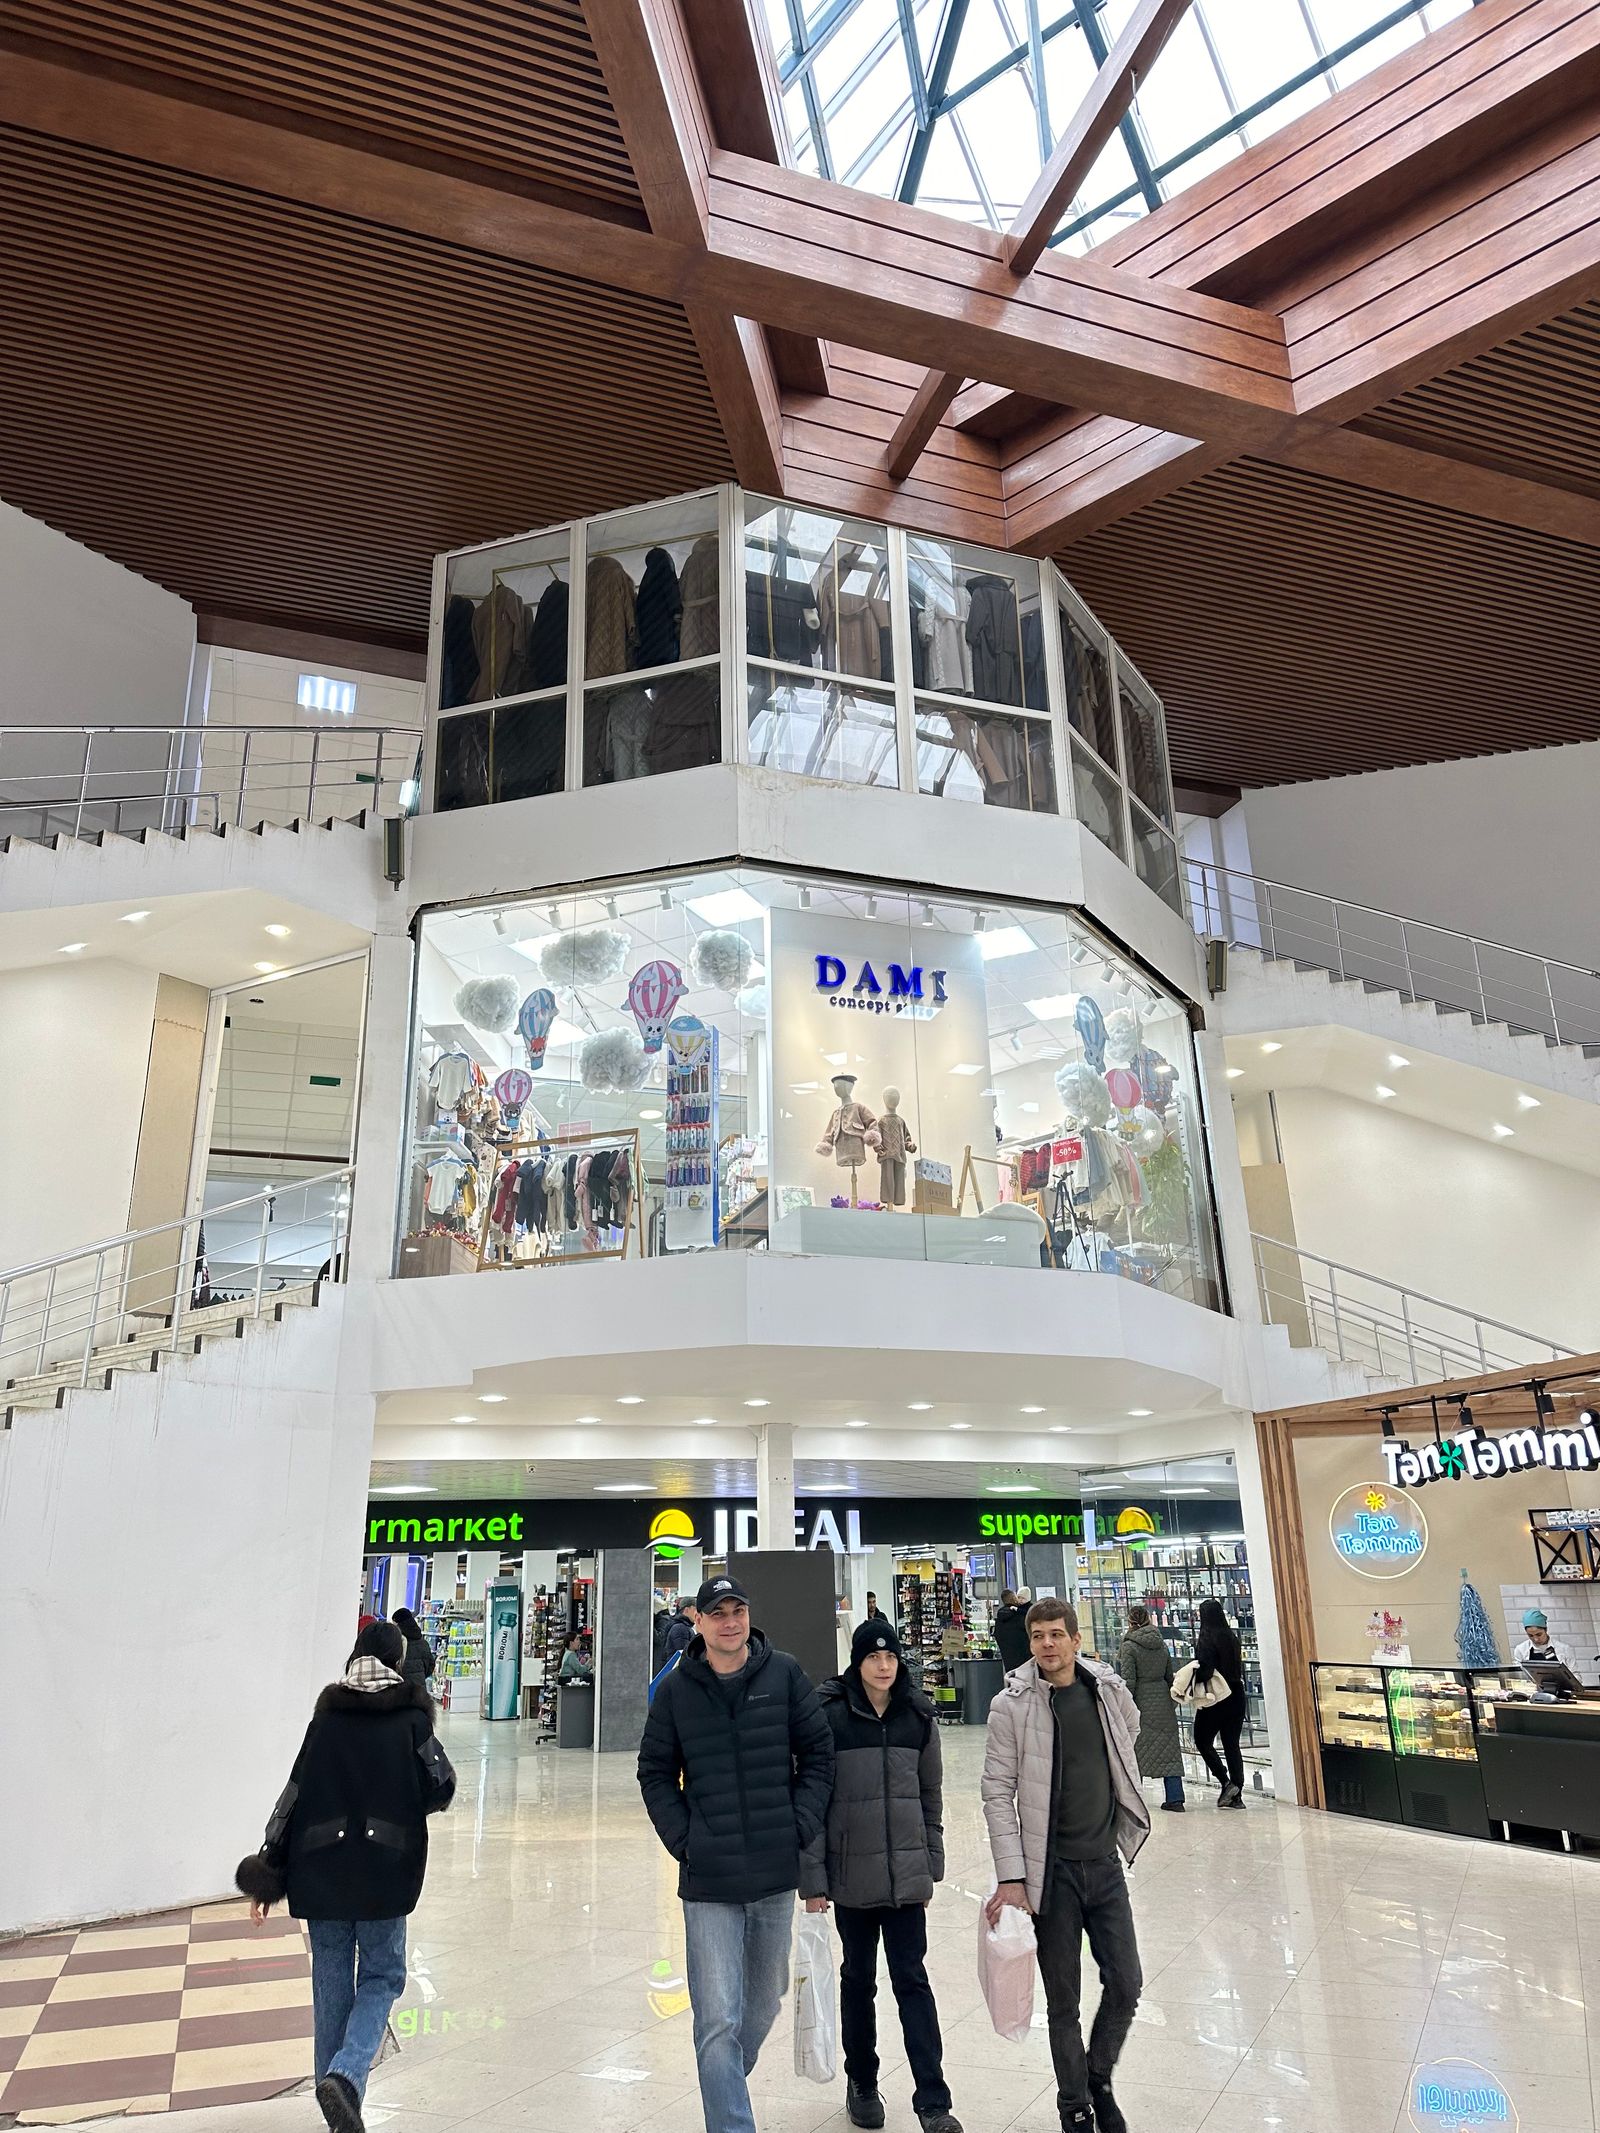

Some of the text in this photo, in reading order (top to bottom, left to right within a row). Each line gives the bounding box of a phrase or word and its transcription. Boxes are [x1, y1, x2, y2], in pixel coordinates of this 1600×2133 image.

[814, 954, 949, 1002] DAMI
[829, 996, 891, 1015] concept
[1056, 1146, 1077, 1157] -50%
[981, 1511, 1166, 1544] supermart
[495, 1595, 518, 1603] BORJOMI
[497, 1630, 509, 1661] BORJOMI
